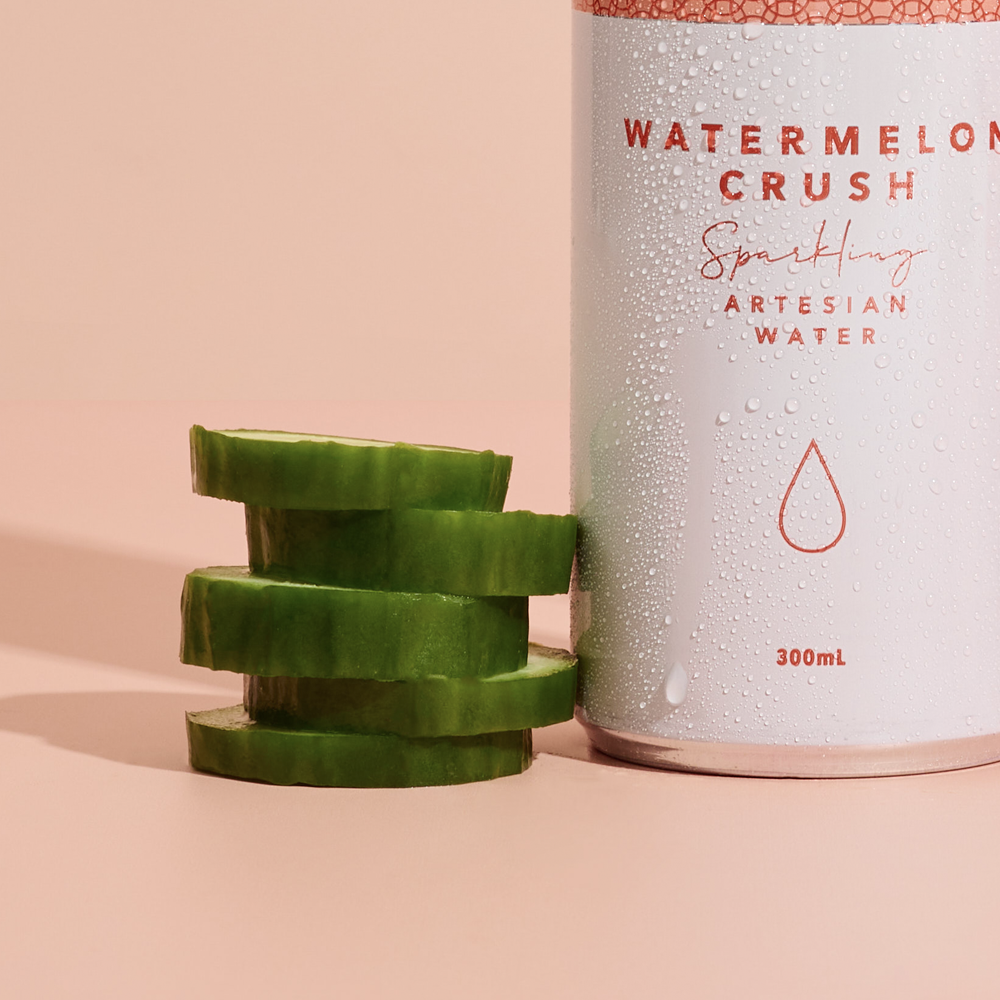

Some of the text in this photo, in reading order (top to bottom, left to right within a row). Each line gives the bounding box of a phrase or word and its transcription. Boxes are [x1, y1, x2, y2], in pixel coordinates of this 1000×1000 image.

[719, 170, 916, 201] CRUSH
[700, 219, 928, 288] Sparkling
[724, 294, 907, 315] ARTESIAN
[755, 327, 877, 345] WATER
[776, 648, 846, 667] 300mL
